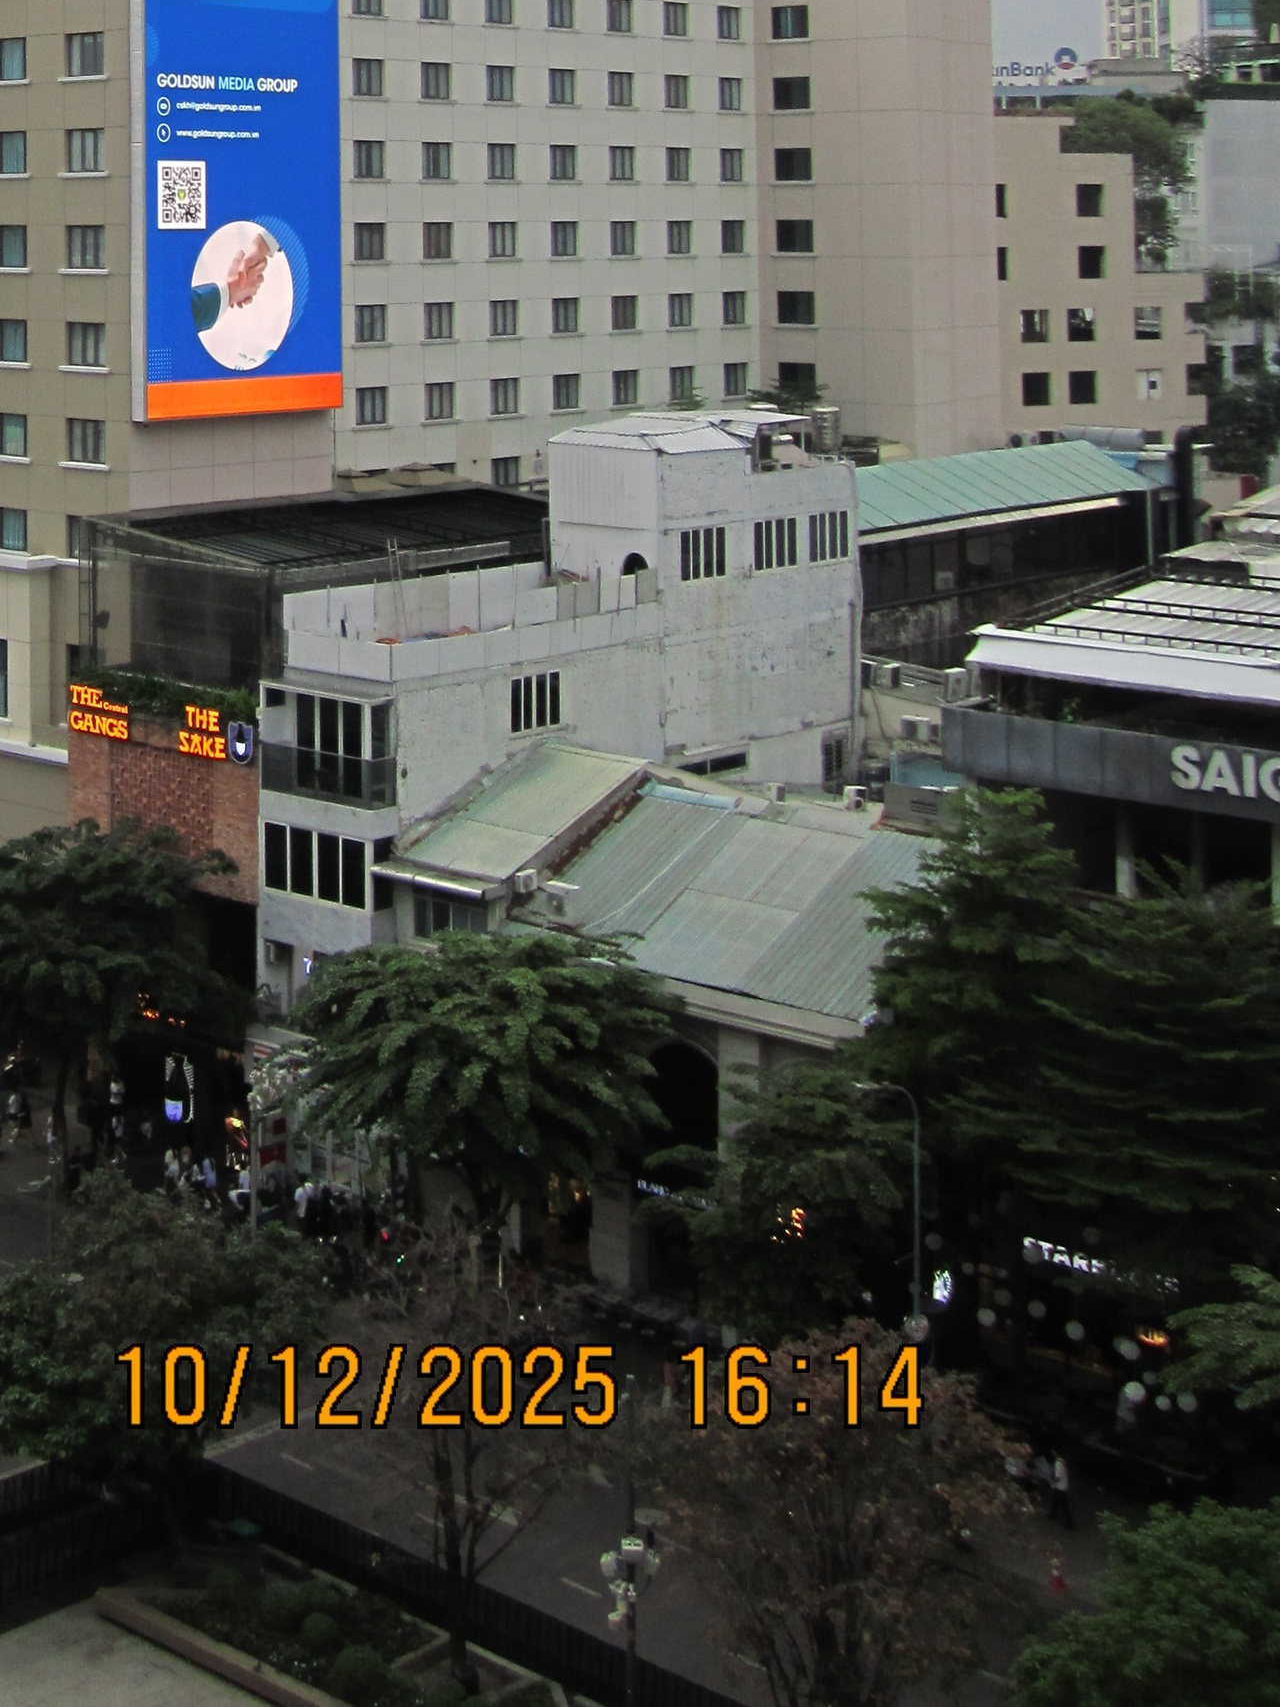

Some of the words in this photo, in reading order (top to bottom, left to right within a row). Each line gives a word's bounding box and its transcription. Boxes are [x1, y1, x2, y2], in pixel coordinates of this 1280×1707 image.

[156, 73, 215, 90] GOLDSUN
[218, 76, 255, 91] MEDIA
[256, 77, 298, 93] GROUP
[70, 684, 103, 709] THE
[70, 710, 129, 740] GANGS
[185, 705, 220, 732] THE
[178, 730, 227, 759] SAKE
